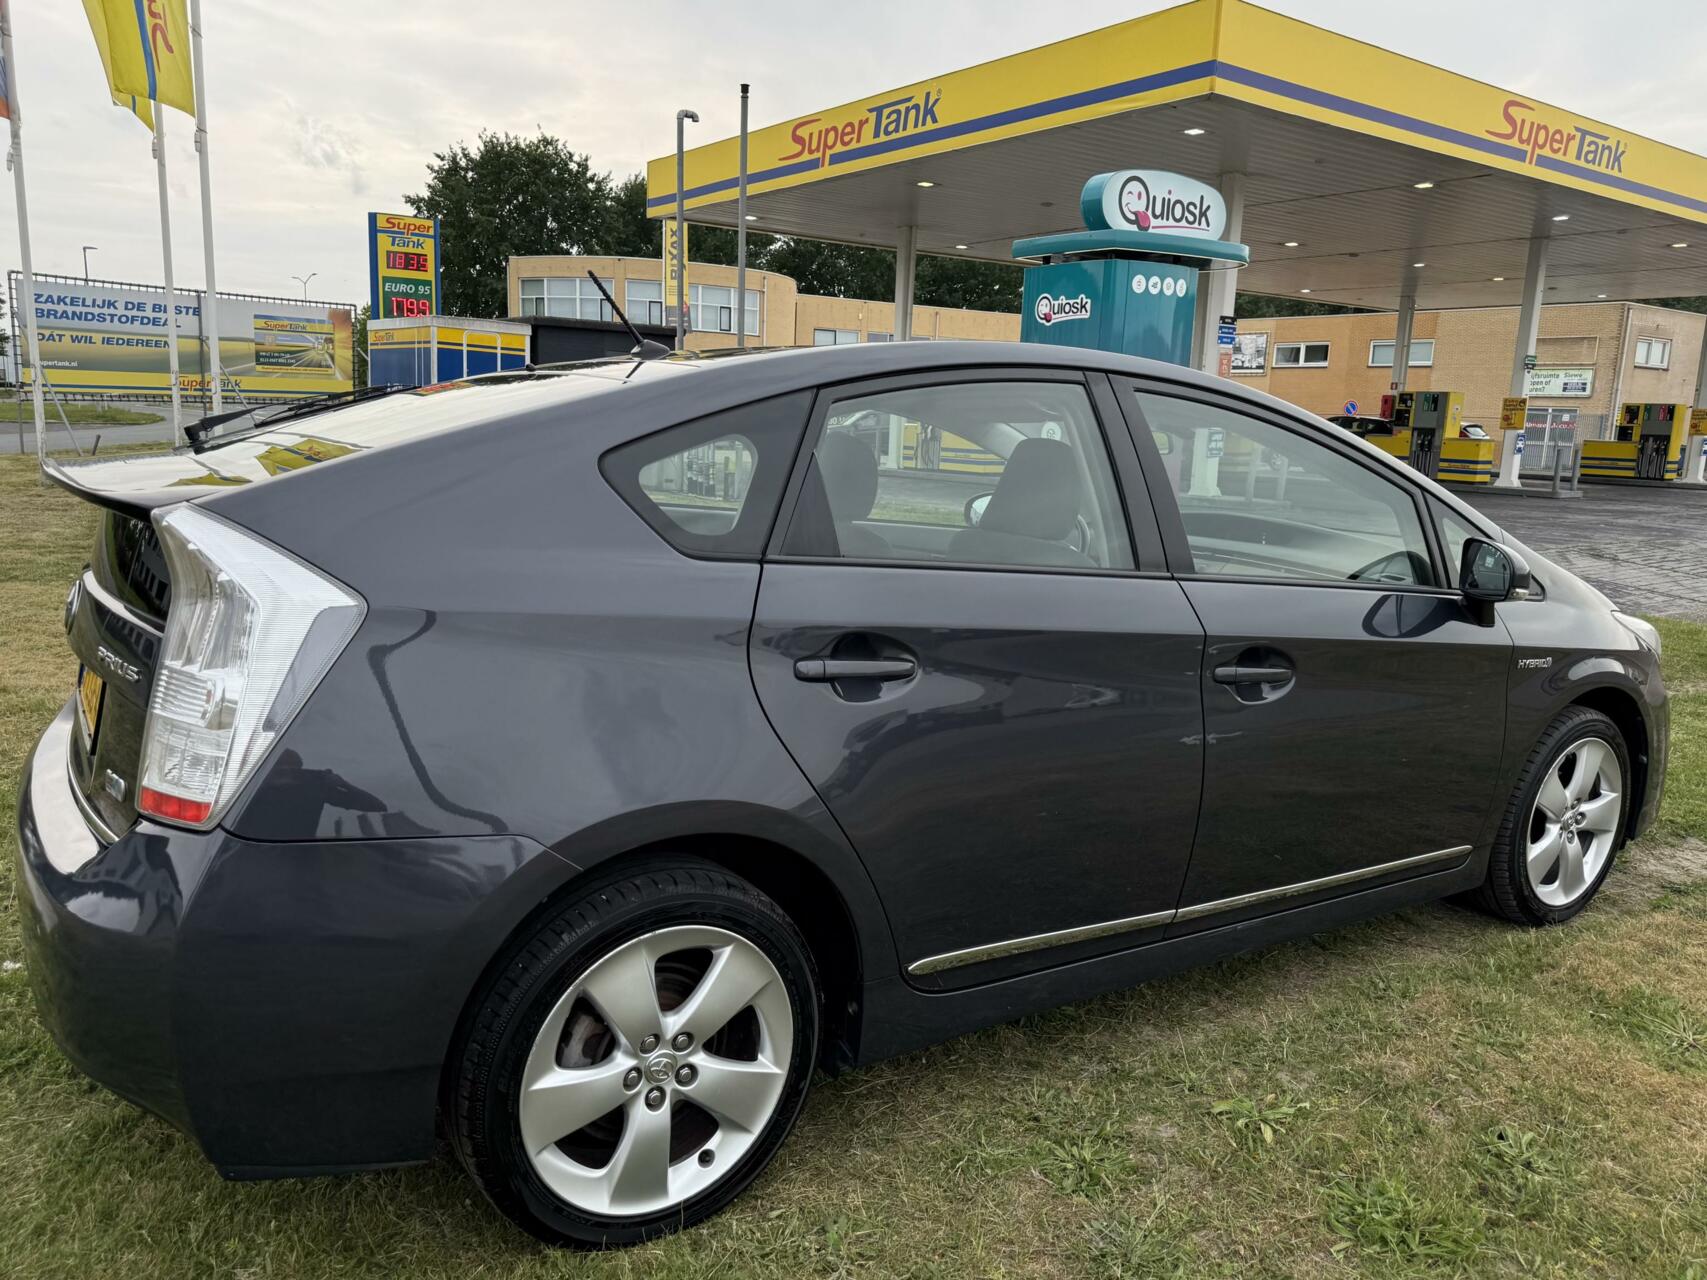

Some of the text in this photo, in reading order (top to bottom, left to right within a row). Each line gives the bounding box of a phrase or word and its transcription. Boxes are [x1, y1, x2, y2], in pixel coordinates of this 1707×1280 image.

[1118, 175, 1211, 231] Quiosk
[379, 216, 433, 236] Super
[386, 235, 425, 250] Tank
[384, 282, 431, 295] EURO 95
[33, 292, 119, 311] ZAKELIJK
[124, 300, 147, 313] DE
[1036, 295, 1089, 323] Quiosk
[70, 334, 97, 345] WIL
[38, 360, 79, 368] upertank.nl
[166, 375, 242, 394] uperank
[98, 646, 140, 682] PRIUS
[1517, 658, 1547, 669] HYBRID
